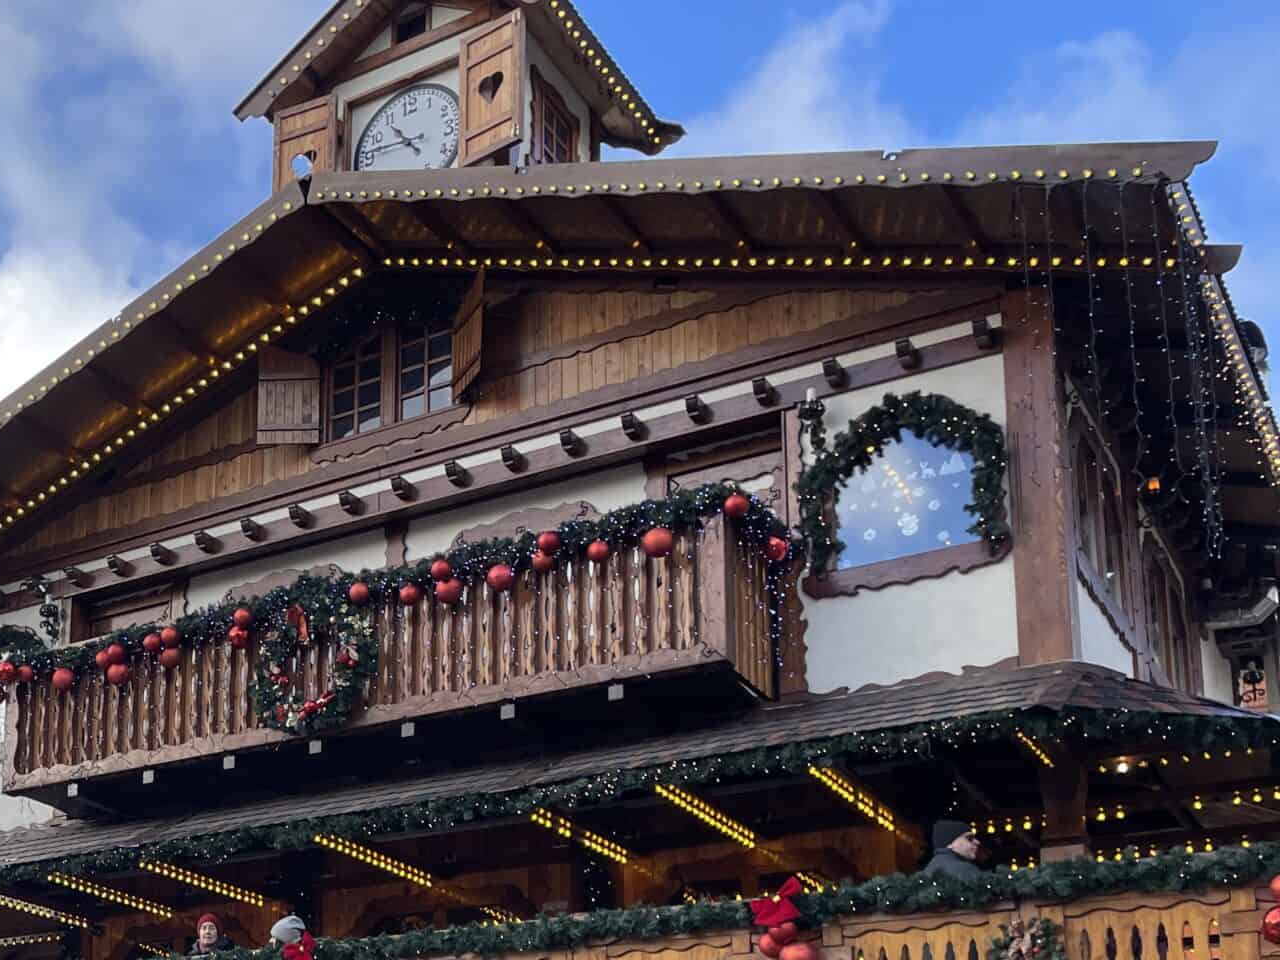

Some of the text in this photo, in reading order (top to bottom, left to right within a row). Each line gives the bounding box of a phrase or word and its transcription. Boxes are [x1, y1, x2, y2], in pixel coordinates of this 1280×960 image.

[403, 96, 418, 117] 12
[443, 119, 454, 136] 3
[371, 131, 383, 145] 10
[364, 151, 375, 168] 9
